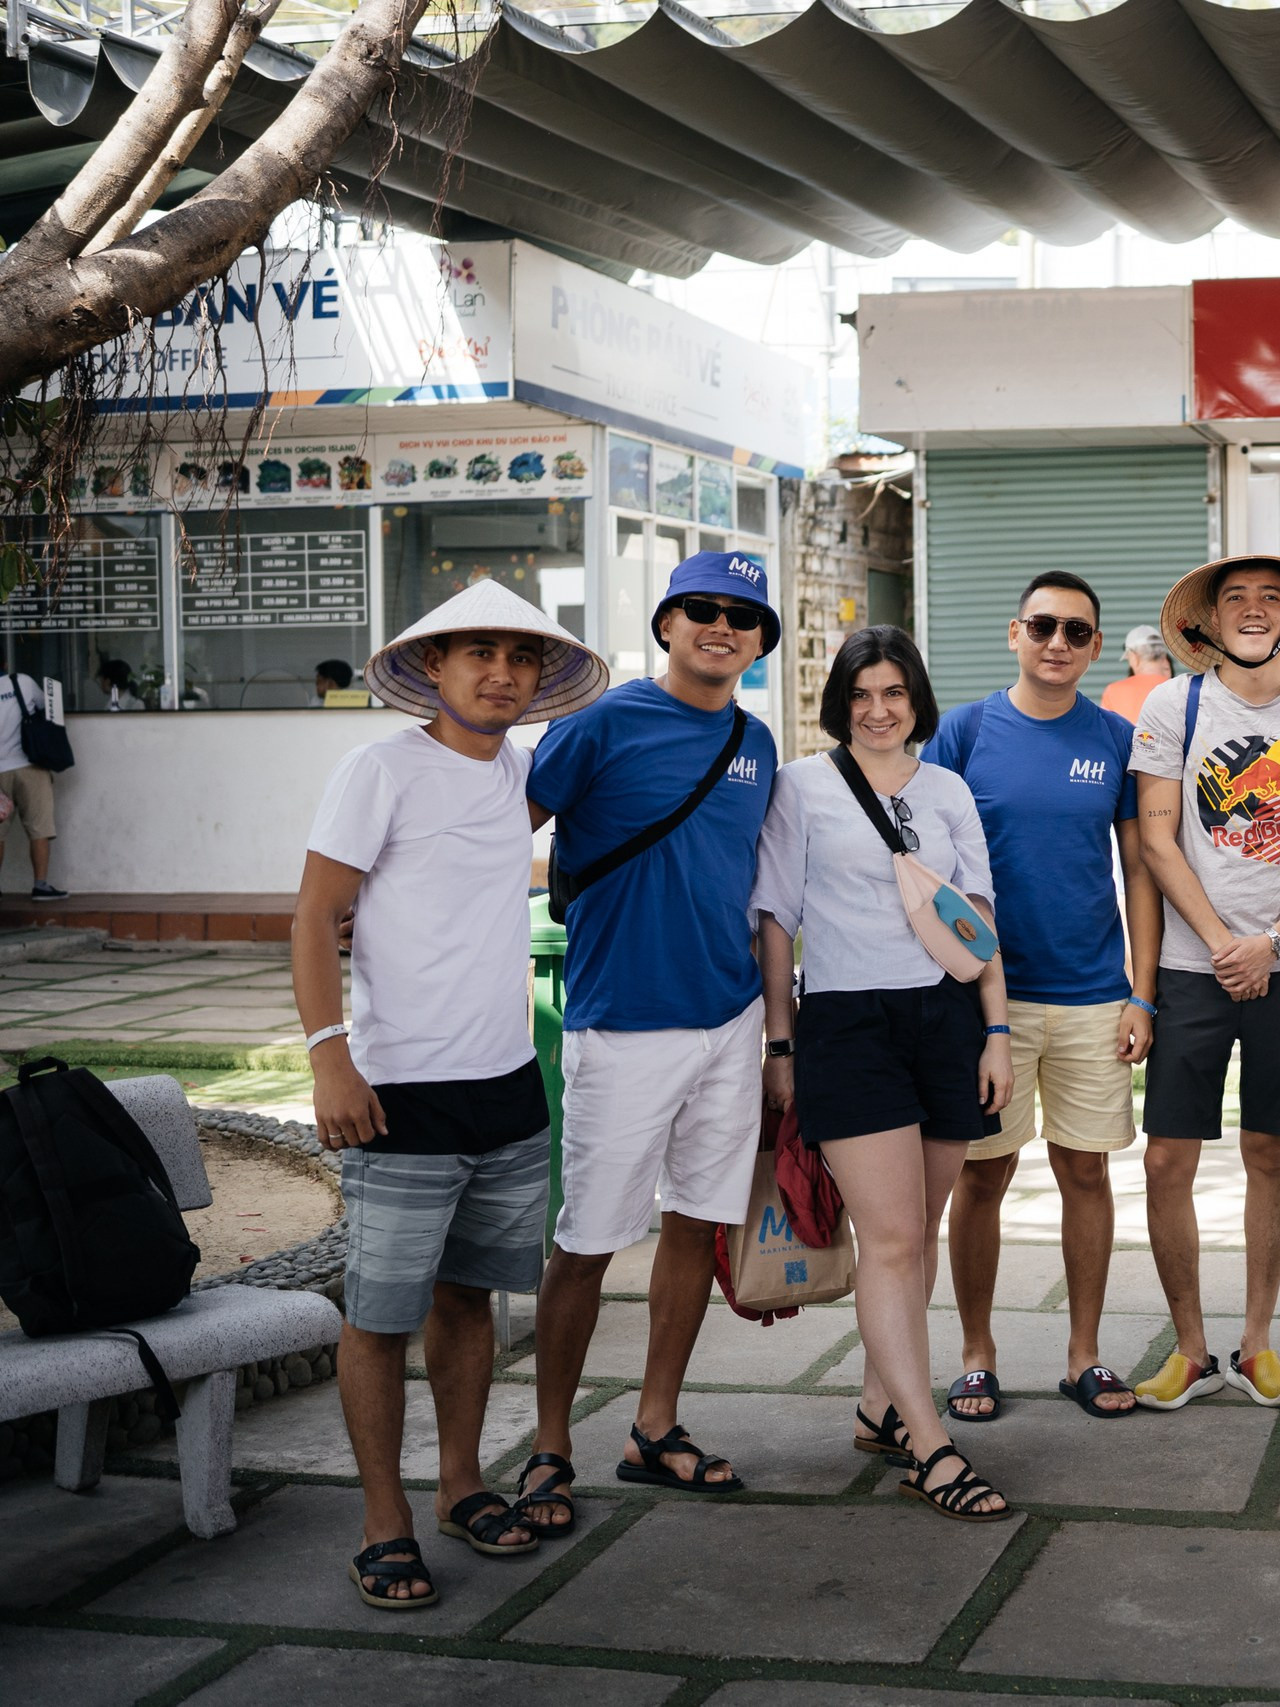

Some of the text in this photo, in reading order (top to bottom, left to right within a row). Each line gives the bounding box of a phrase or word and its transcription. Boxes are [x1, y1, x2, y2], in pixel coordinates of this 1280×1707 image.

[273, 268, 340, 321] VÉ
[328, 444, 356, 453] ISLAND
[728, 557, 761, 583] MH
[727, 755, 758, 781] MH
[1069, 758, 1106, 781] MH
[1210, 820, 1258, 848] Red
[760, 1246, 792, 1255] MARINE
